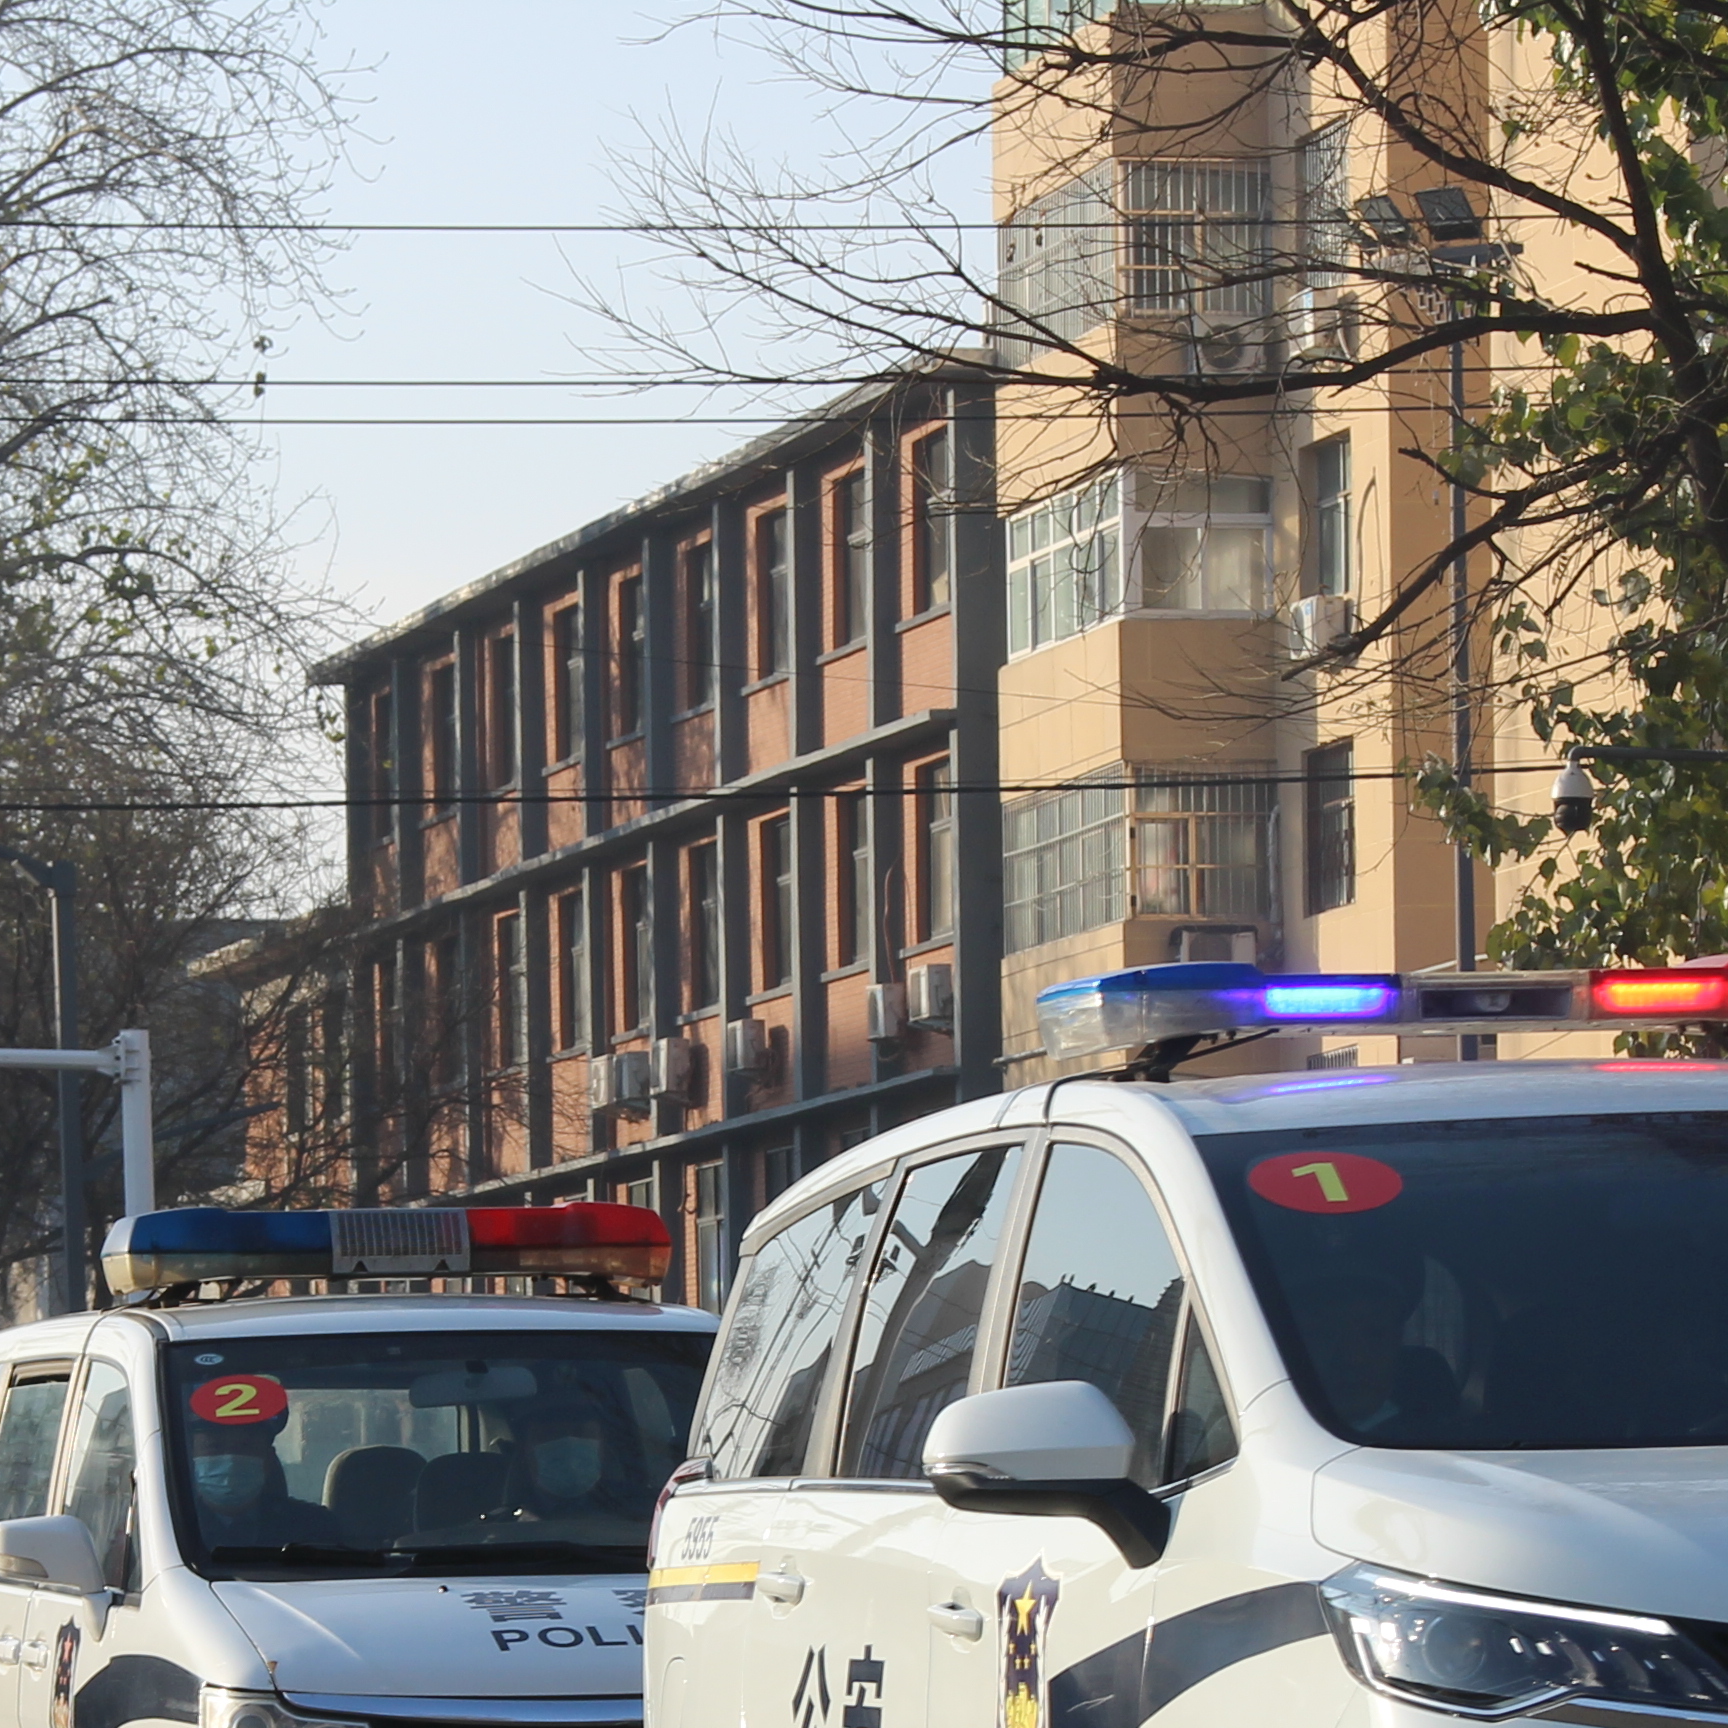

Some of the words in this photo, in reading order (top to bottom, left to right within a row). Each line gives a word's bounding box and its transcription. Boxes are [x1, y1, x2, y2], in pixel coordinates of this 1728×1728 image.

[1291, 1162, 1349, 1202] 1
[215, 1383, 260, 1417] 2
[681, 1514, 720, 1560] 5955
